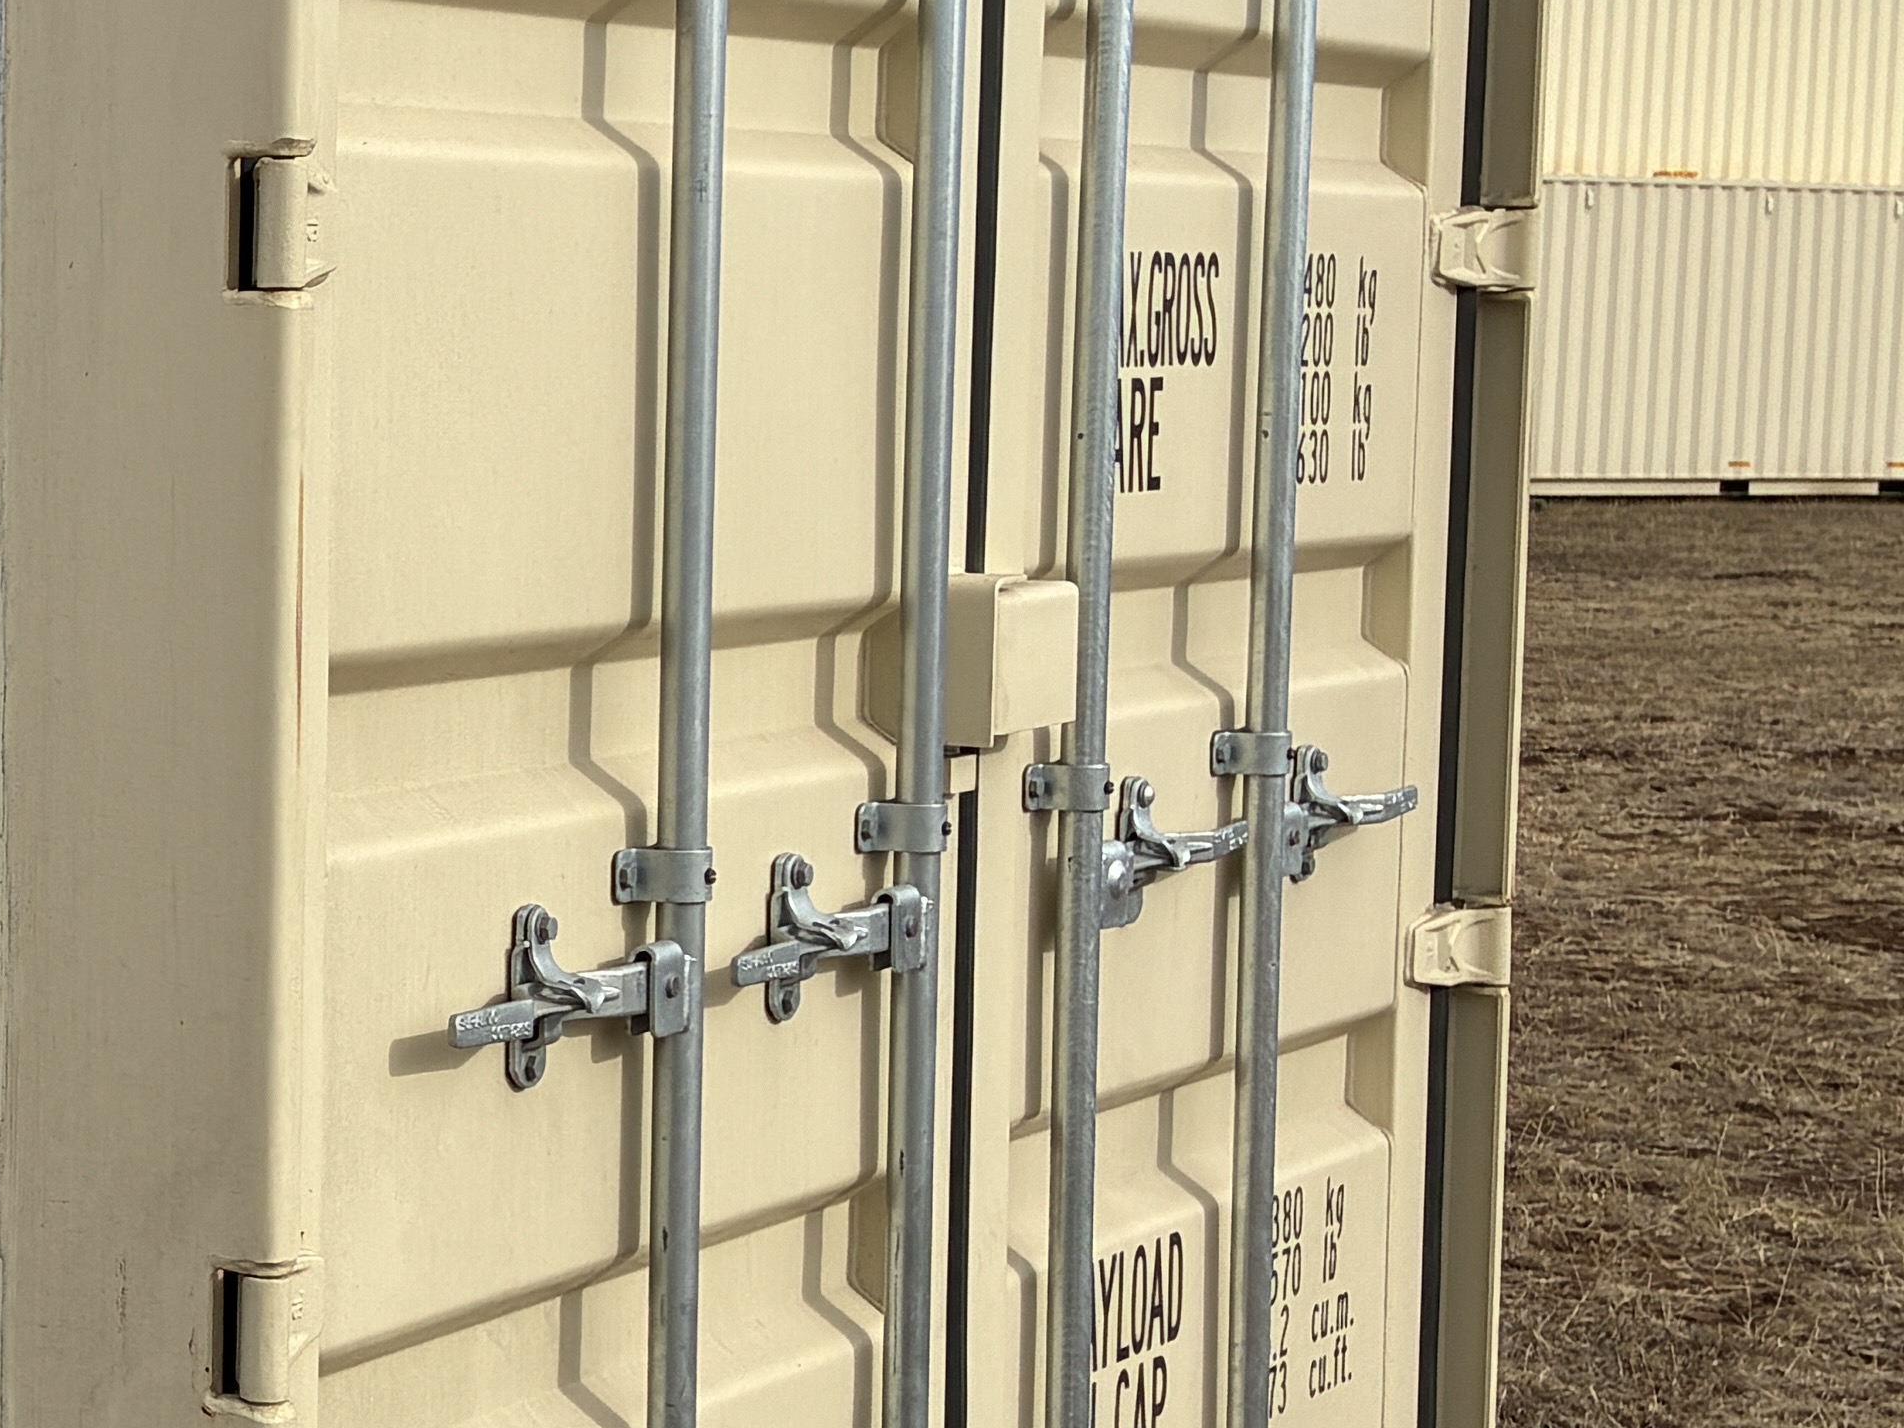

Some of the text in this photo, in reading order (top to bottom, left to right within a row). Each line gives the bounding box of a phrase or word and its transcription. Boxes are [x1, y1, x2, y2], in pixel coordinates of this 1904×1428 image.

[1119, 250, 1220, 368] X.GROSS
[1357, 255, 1377, 326] kg
[1354, 312, 1370, 367] lb
[1352, 370, 1372, 441] kg
[1351, 428, 1366, 482] lb
[1325, 1175, 1345, 1240] kg
[1322, 1230, 1338, 1284] lb
[1091, 1231, 1184, 1373] YLOAD
[1311, 1291, 1354, 1344] cu.m.
[1308, 1333, 1352, 1399] cu.ft.
